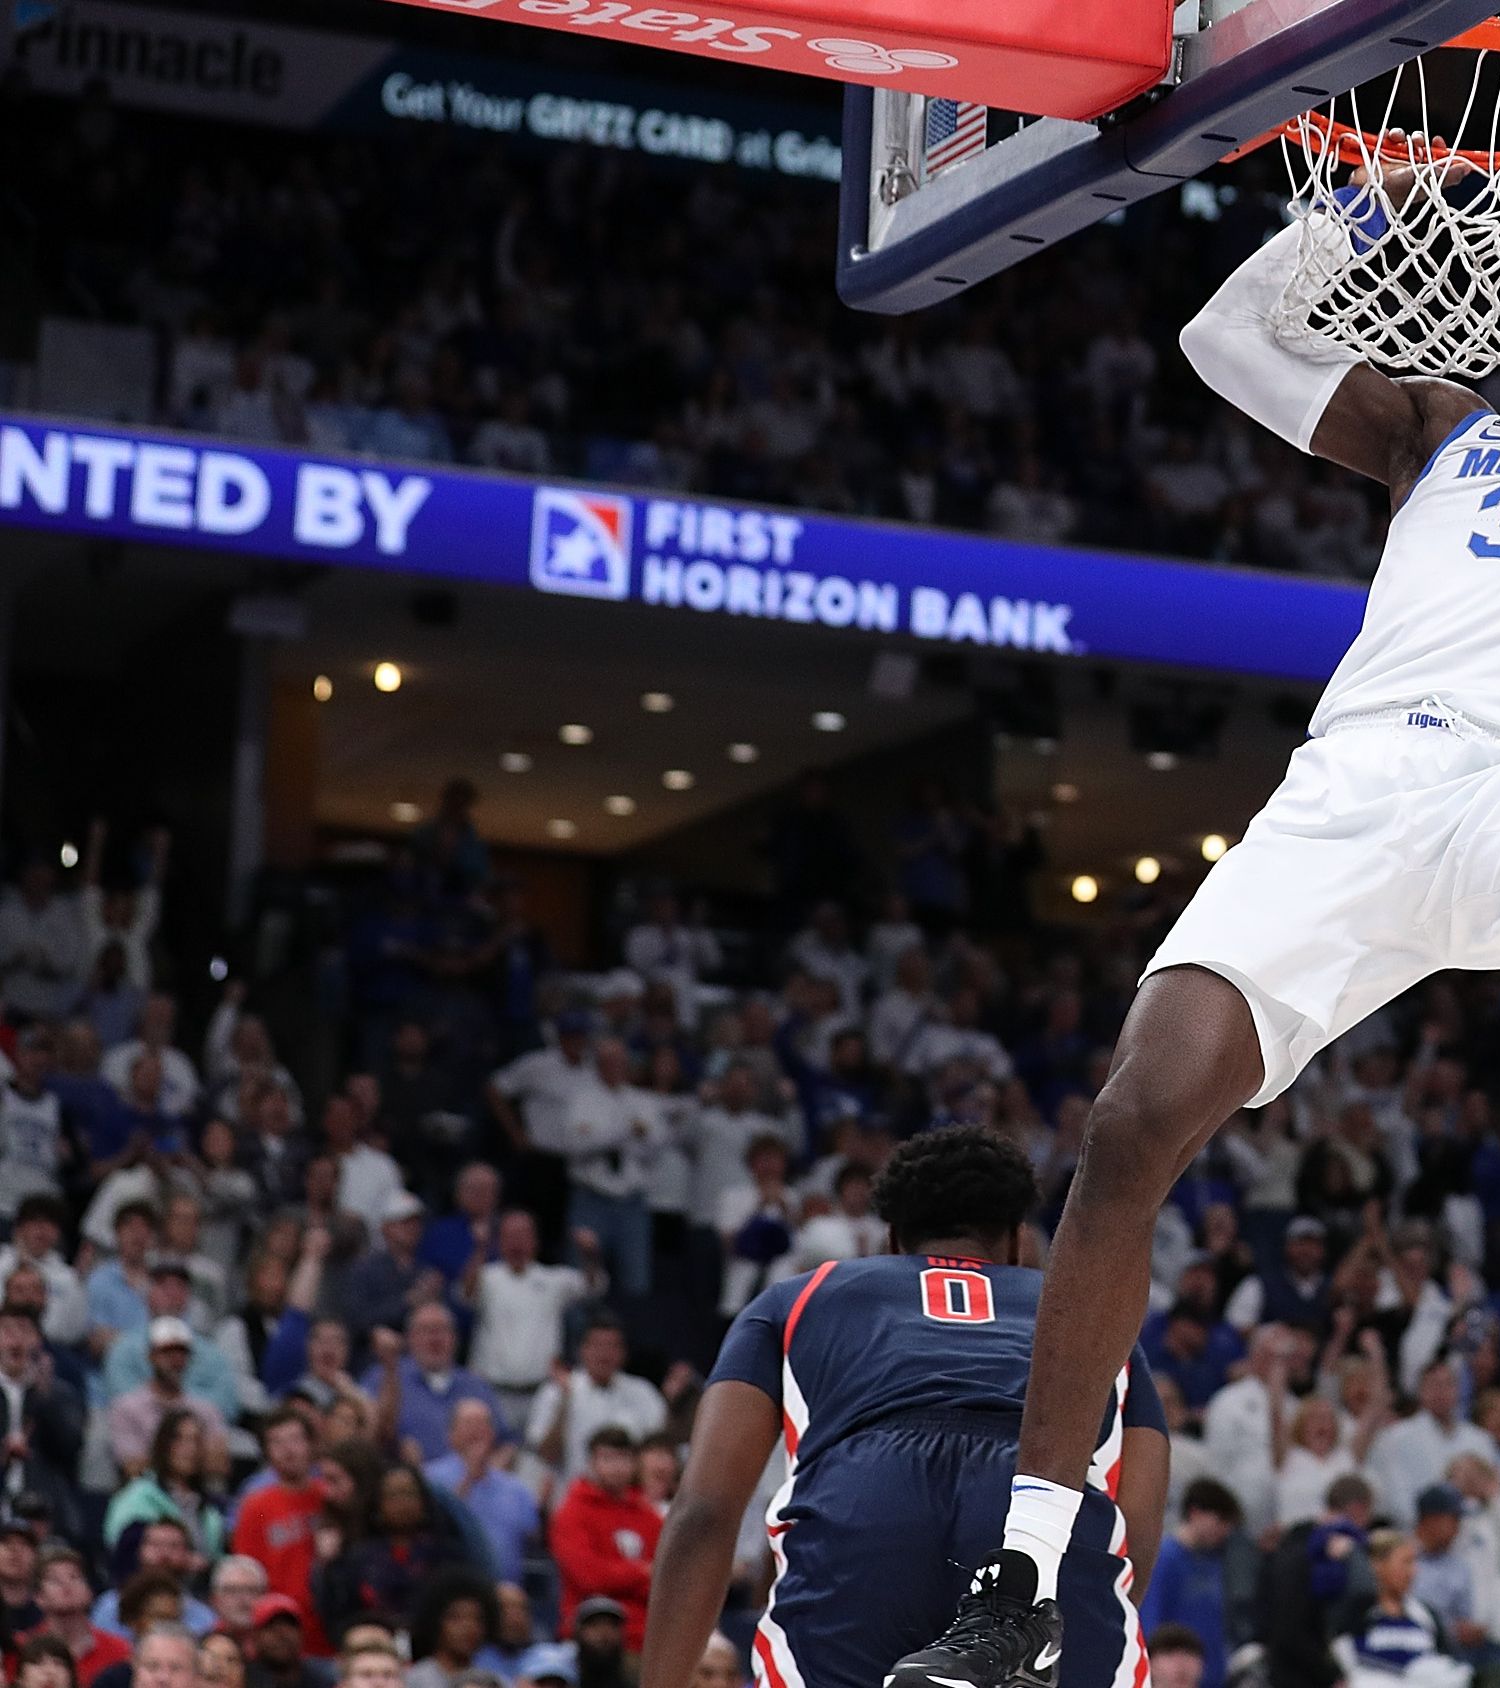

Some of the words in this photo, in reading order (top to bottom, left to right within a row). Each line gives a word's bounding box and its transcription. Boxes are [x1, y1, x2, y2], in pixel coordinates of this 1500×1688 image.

[518, 0, 801, 52] State
[0, 426, 271, 535] NTED
[293, 462, 431, 555] BY
[645, 500, 802, 564] FIRST
[642, 555, 899, 632] HORIZON
[919, 1268, 995, 1324] 0
